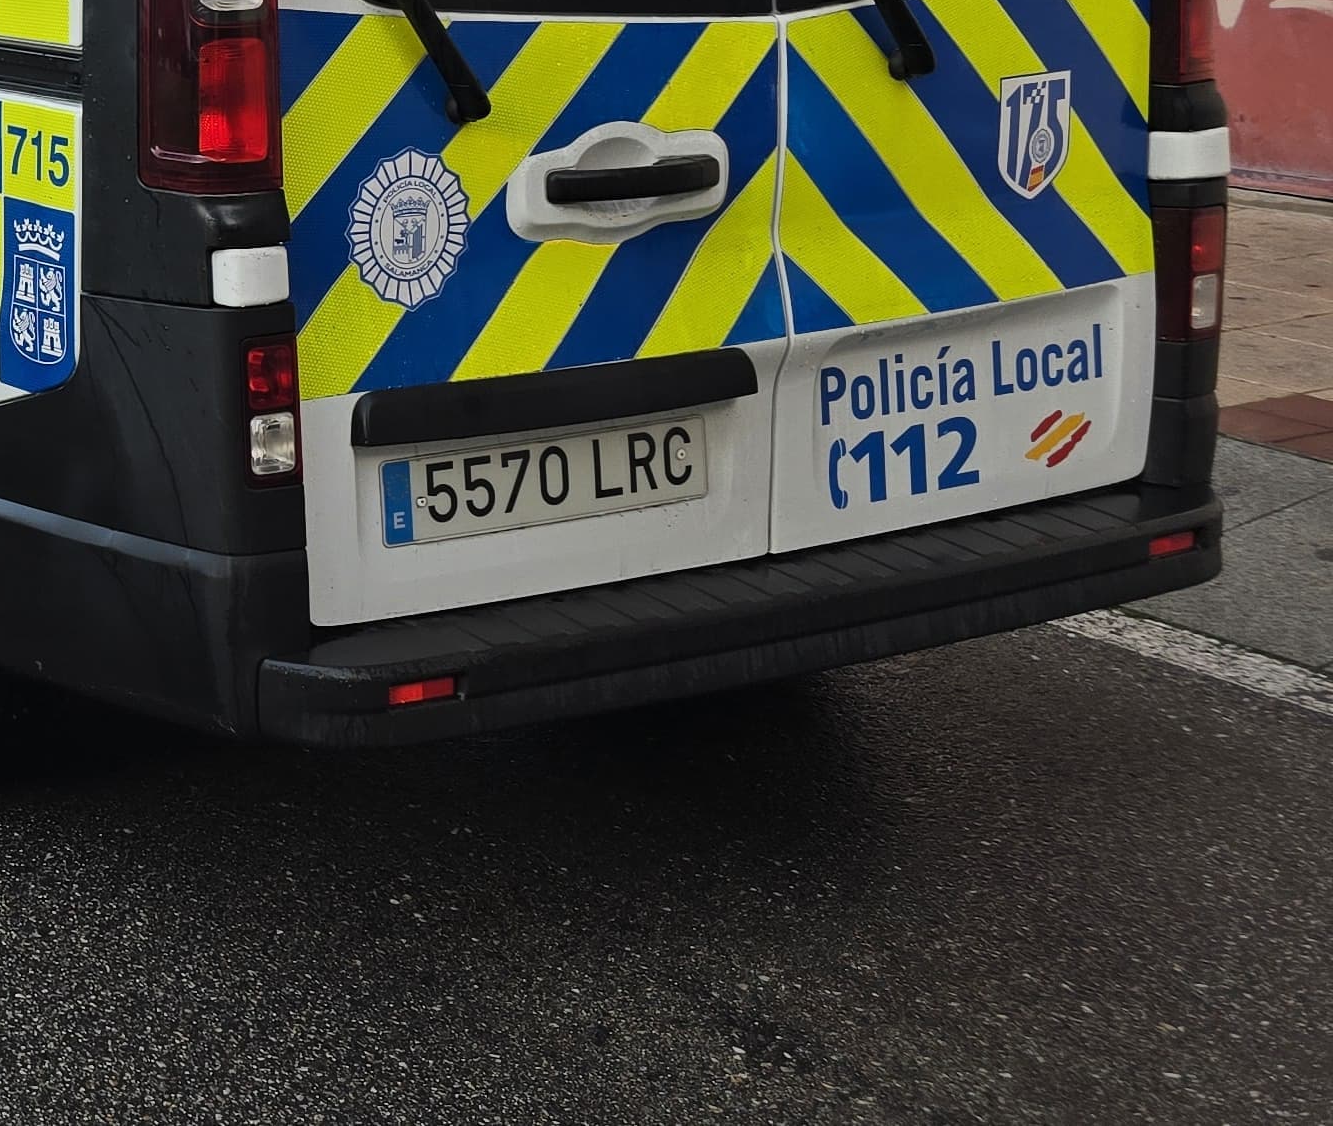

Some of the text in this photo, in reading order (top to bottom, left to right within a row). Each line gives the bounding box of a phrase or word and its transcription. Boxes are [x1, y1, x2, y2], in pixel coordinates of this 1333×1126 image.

[7, 124, 70, 188] 715
[383, 180, 437, 203] POLICÍA LOCAL
[820, 323, 1103, 426] Policía Local
[425, 426, 693, 523] 5570 LRC
[848, 416, 980, 503] 112
[393, 511, 406, 529] E
